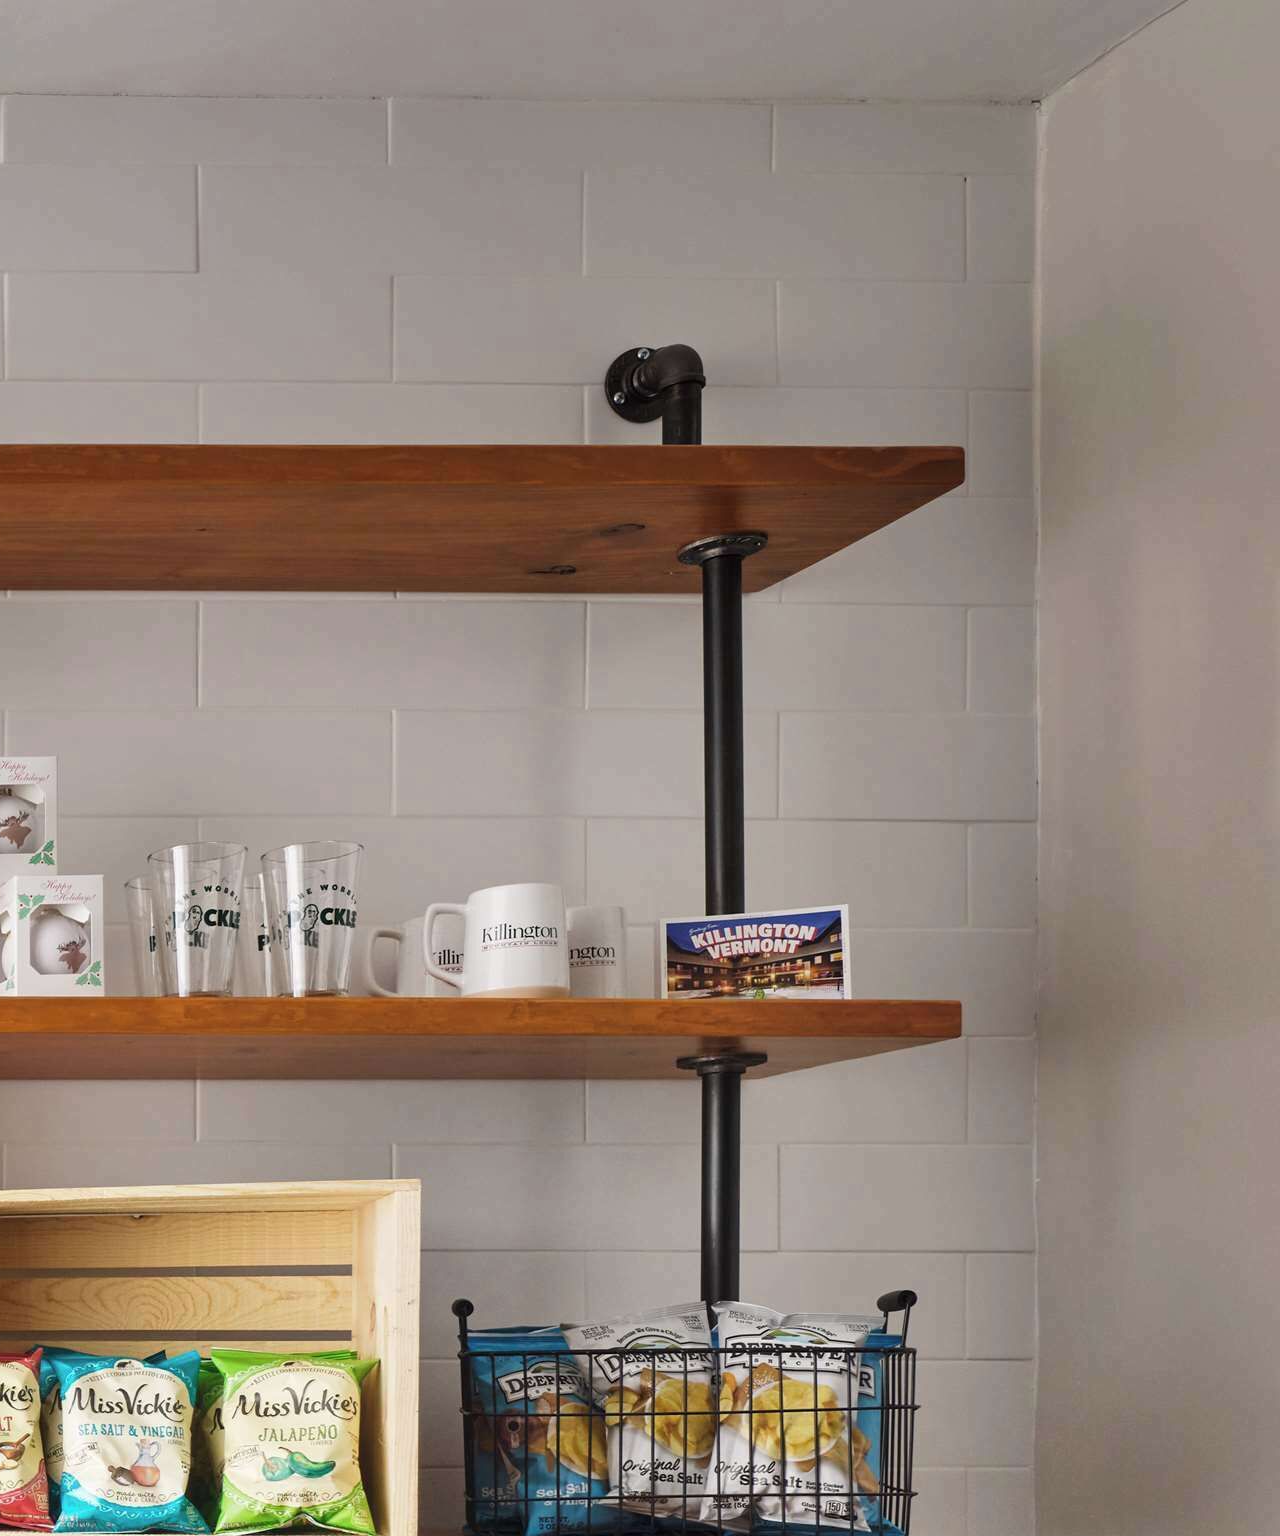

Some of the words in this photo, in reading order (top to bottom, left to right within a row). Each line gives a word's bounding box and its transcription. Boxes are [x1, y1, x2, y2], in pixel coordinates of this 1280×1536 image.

[41, 879, 73, 894] Happy
[482, 923, 559, 944] Killington
[690, 923, 818, 949] KILLINGTON
[706, 939, 802, 960] VERMONT
[68, 1386, 124, 1415] Miss
[232, 1391, 290, 1420] Miss
[283, 1378, 359, 1421] Vickie's
[79, 1423, 98, 1436] SEA
[100, 1423, 125, 1437] SALT
[128, 1424, 139, 1438] &
[140, 1424, 185, 1440] VINEGAR
[258, 1423, 338, 1442] JALAPEÑO
[622, 1458, 681, 1476] Original
[714, 1460, 777, 1481] Original
[649, 1471, 674, 1483] Sea
[677, 1472, 704, 1485] Salt
[740, 1475, 770, 1487] Sea
